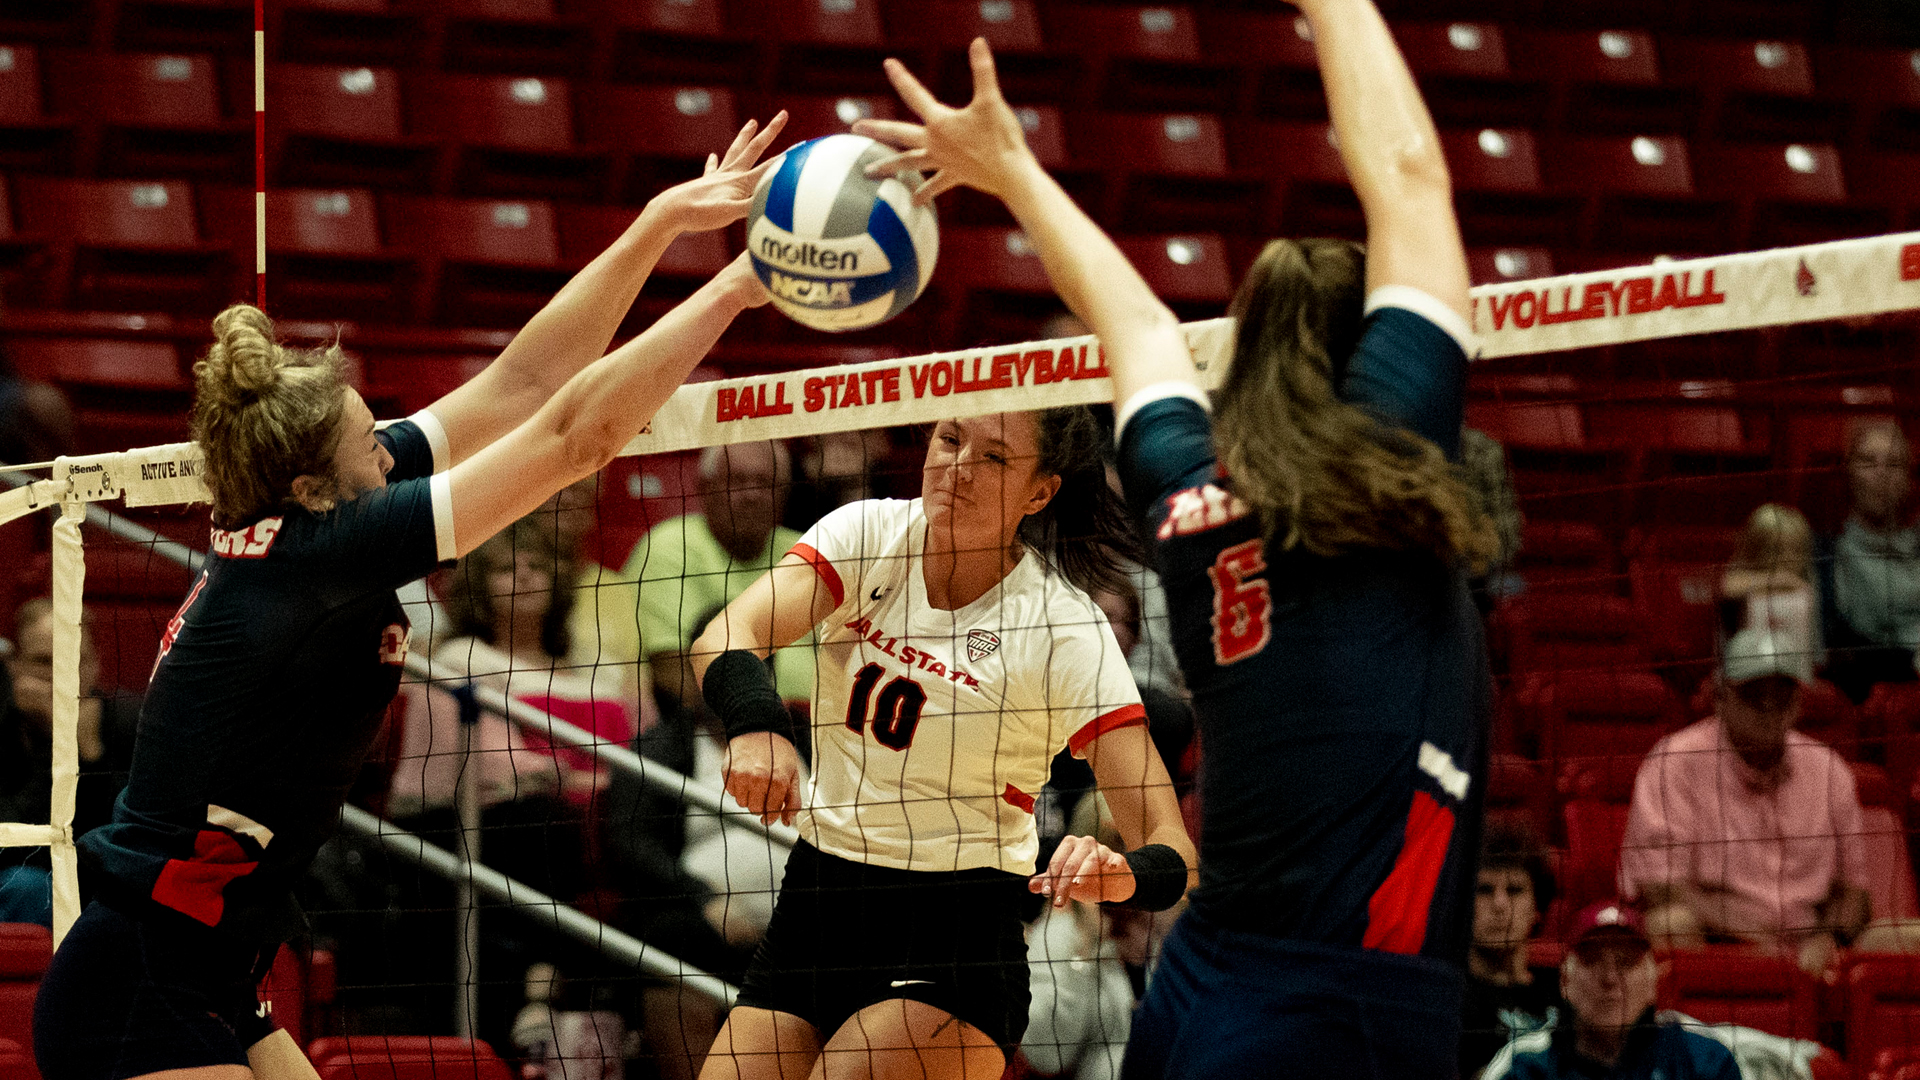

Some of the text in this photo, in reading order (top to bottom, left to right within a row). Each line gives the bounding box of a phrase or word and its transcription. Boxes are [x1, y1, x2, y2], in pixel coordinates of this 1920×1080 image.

[762, 237, 857, 271] molten
[1488, 268, 1724, 331] VOLLEYBALL
[716, 343, 1110, 422] BALL STATE VOLLEYBALL
[141, 461, 177, 480] ACTIVE
[1208, 538, 1273, 666] 6
[845, 662, 928, 752] 10
